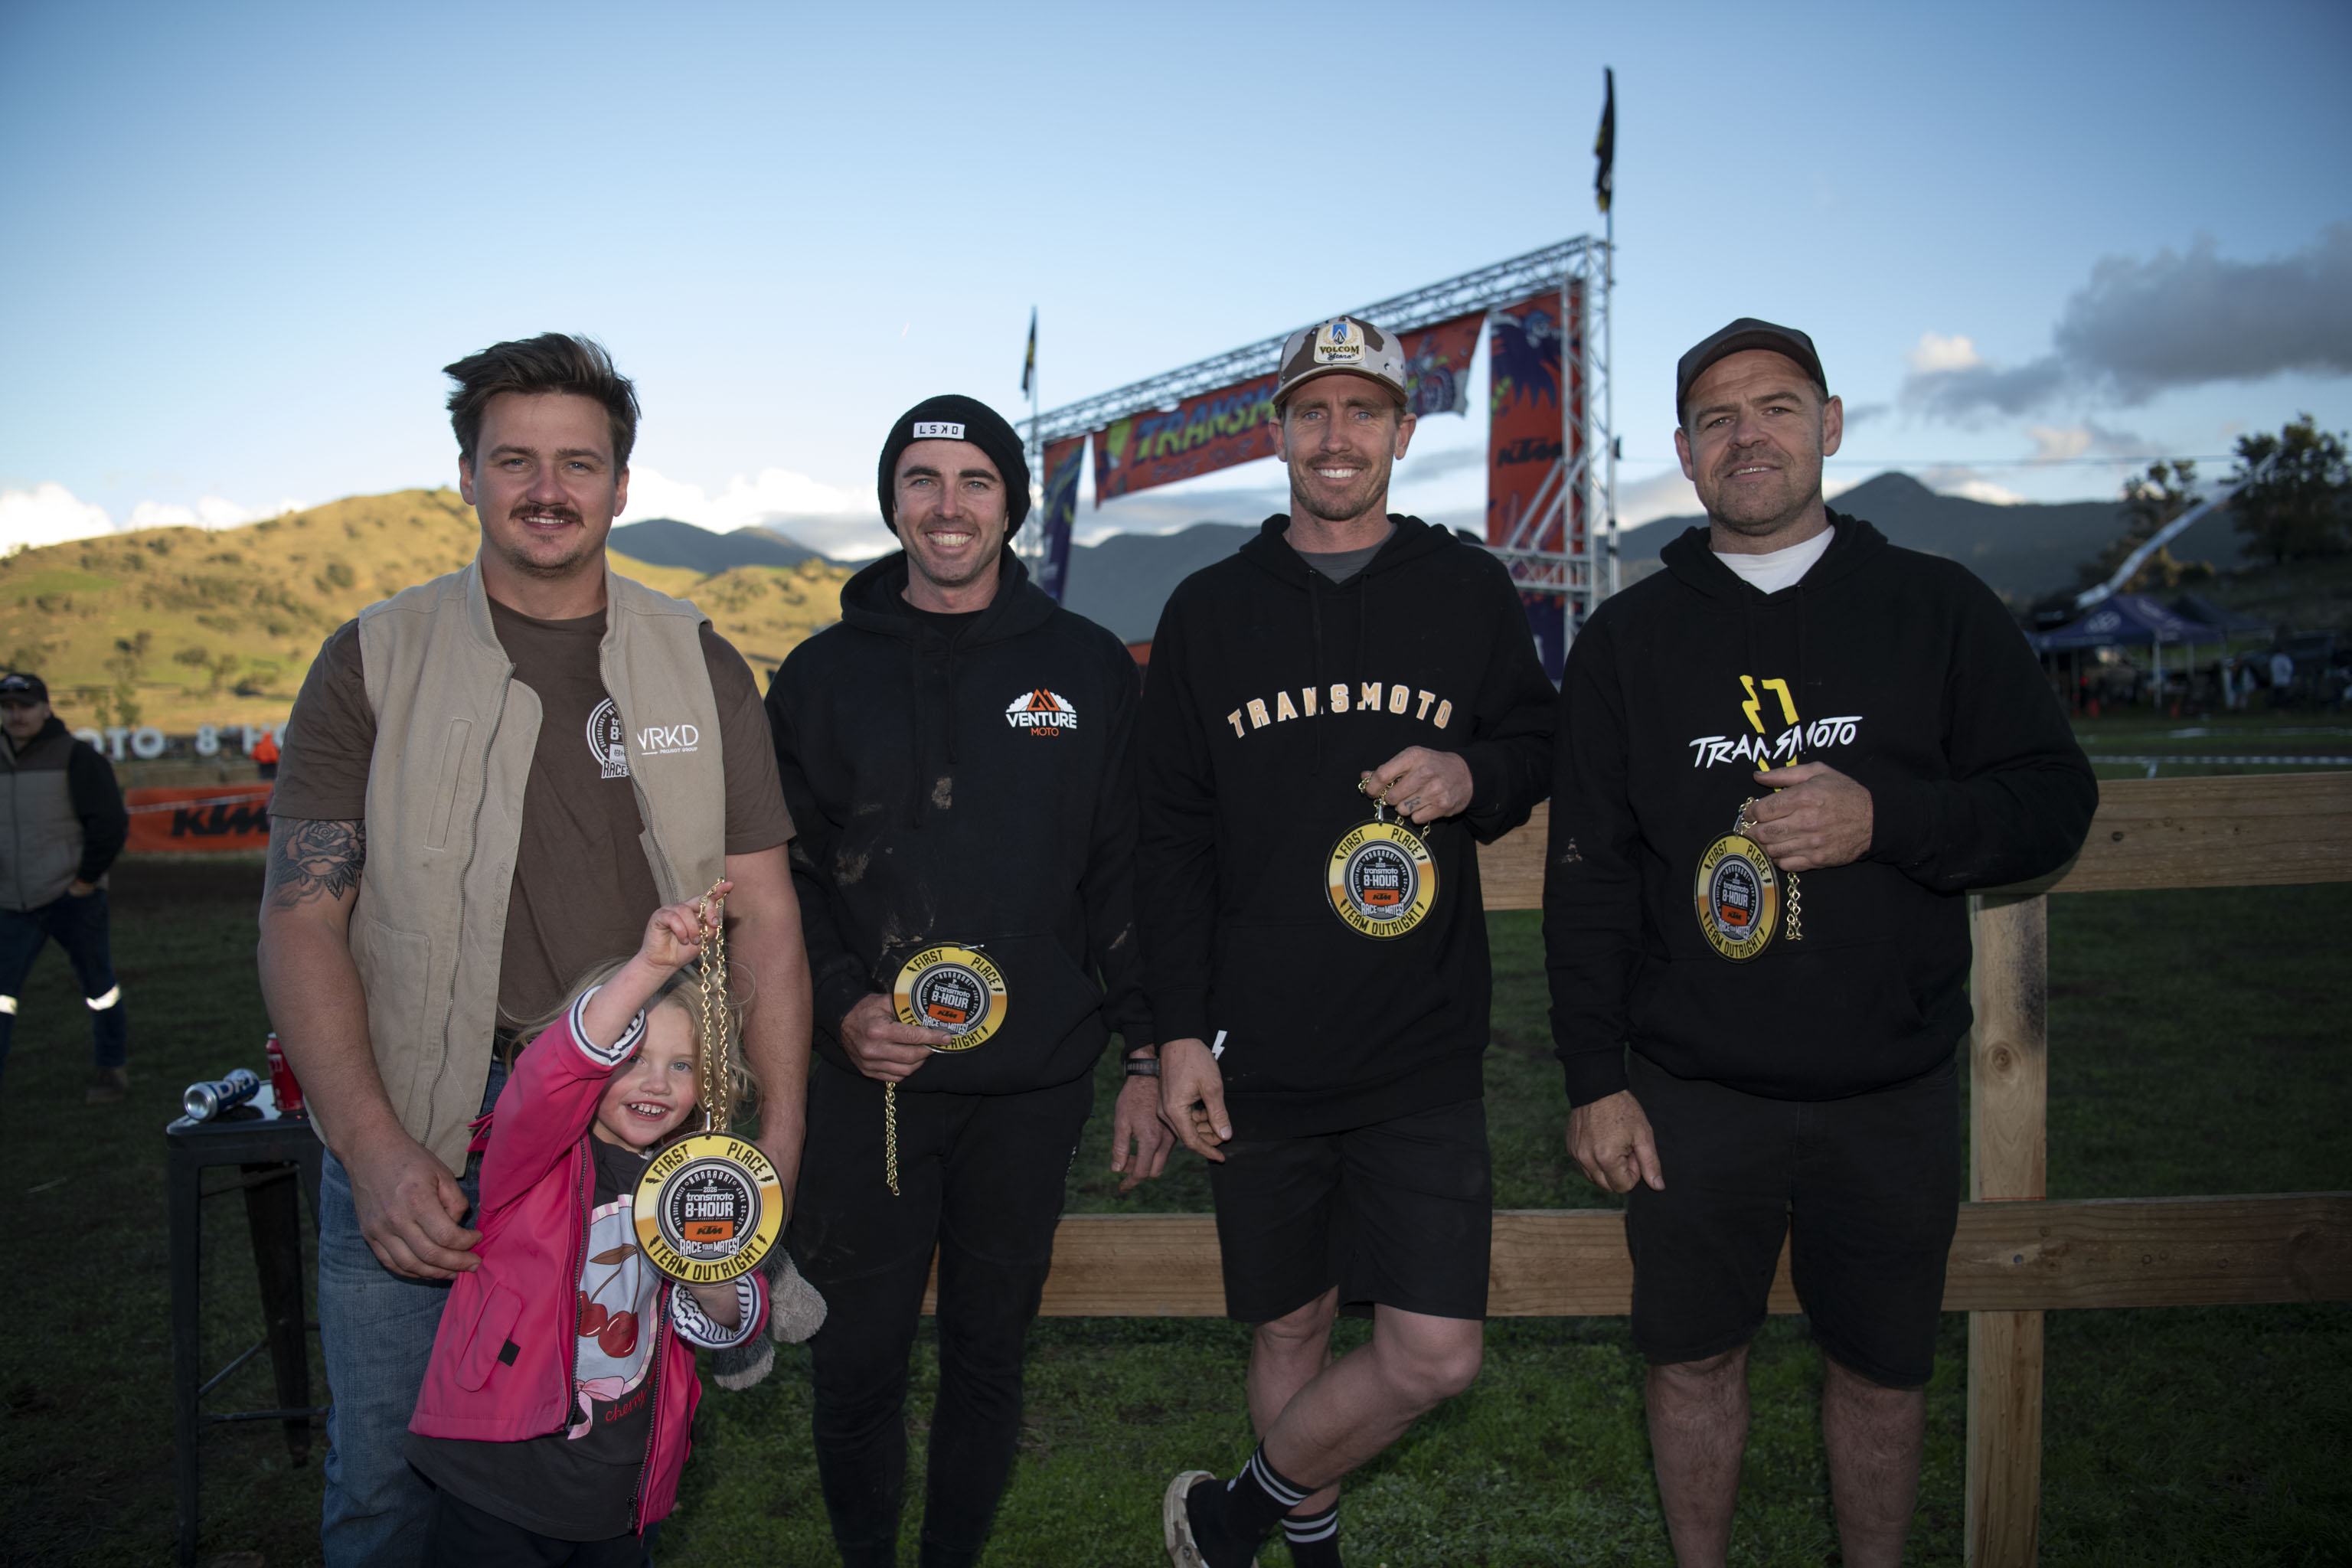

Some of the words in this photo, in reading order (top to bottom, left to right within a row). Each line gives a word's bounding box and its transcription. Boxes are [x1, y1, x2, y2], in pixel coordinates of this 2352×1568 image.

[1319, 345, 1360, 355] VOLCOM
[1227, 682, 1452, 738] TRANSMOTO
[1005, 711, 1077, 729] VENTURE
[195, 724, 220, 756] 8
[1031, 727, 1059, 737] MOTO
[1689, 716, 1864, 768] TRANSMOTO
[603, 760, 627, 778] RACE
[171, 803, 270, 837] KTM
[1340, 829, 1365, 855] FIRST
[1390, 828, 1423, 855] PLACE
[1708, 841, 1728, 866] FIRST
[1746, 844, 1769, 877] PLACE
[1364, 875, 1399, 887] 8-HOUR
[1722, 889, 1749, 907] 8-HOUR
[1361, 903, 1377, 916] RACE
[1343, 905, 1370, 931] TEAM
[1372, 909, 1421, 936] OUTRIGHT
[1705, 920, 1724, 949] TEAM
[1724, 933, 1762, 958] OUTRIGHT
[913, 949, 943, 969] FIRST
[970, 956, 1001, 986] PLACE
[931, 990, 969, 1009] 8-HOUR
[934, 984, 971, 998] transmoto
[922, 1014, 940, 1027] RACE
[653, 1144, 690, 1178] FIRST
[727, 1142, 768, 1176] PLACE
[688, 1171, 733, 1184] NARRABRI
[686, 1192, 734, 1200] transmoto
[685, 1202, 733, 1217] 8-HOUR
[696, 1226, 723, 1235] KTM
[679, 1239, 703, 1256] RACE
[713, 1236, 740, 1256] MATES!
[653, 1244, 691, 1276] TEAM
[692, 1242, 762, 1281] OUTRIGHT
